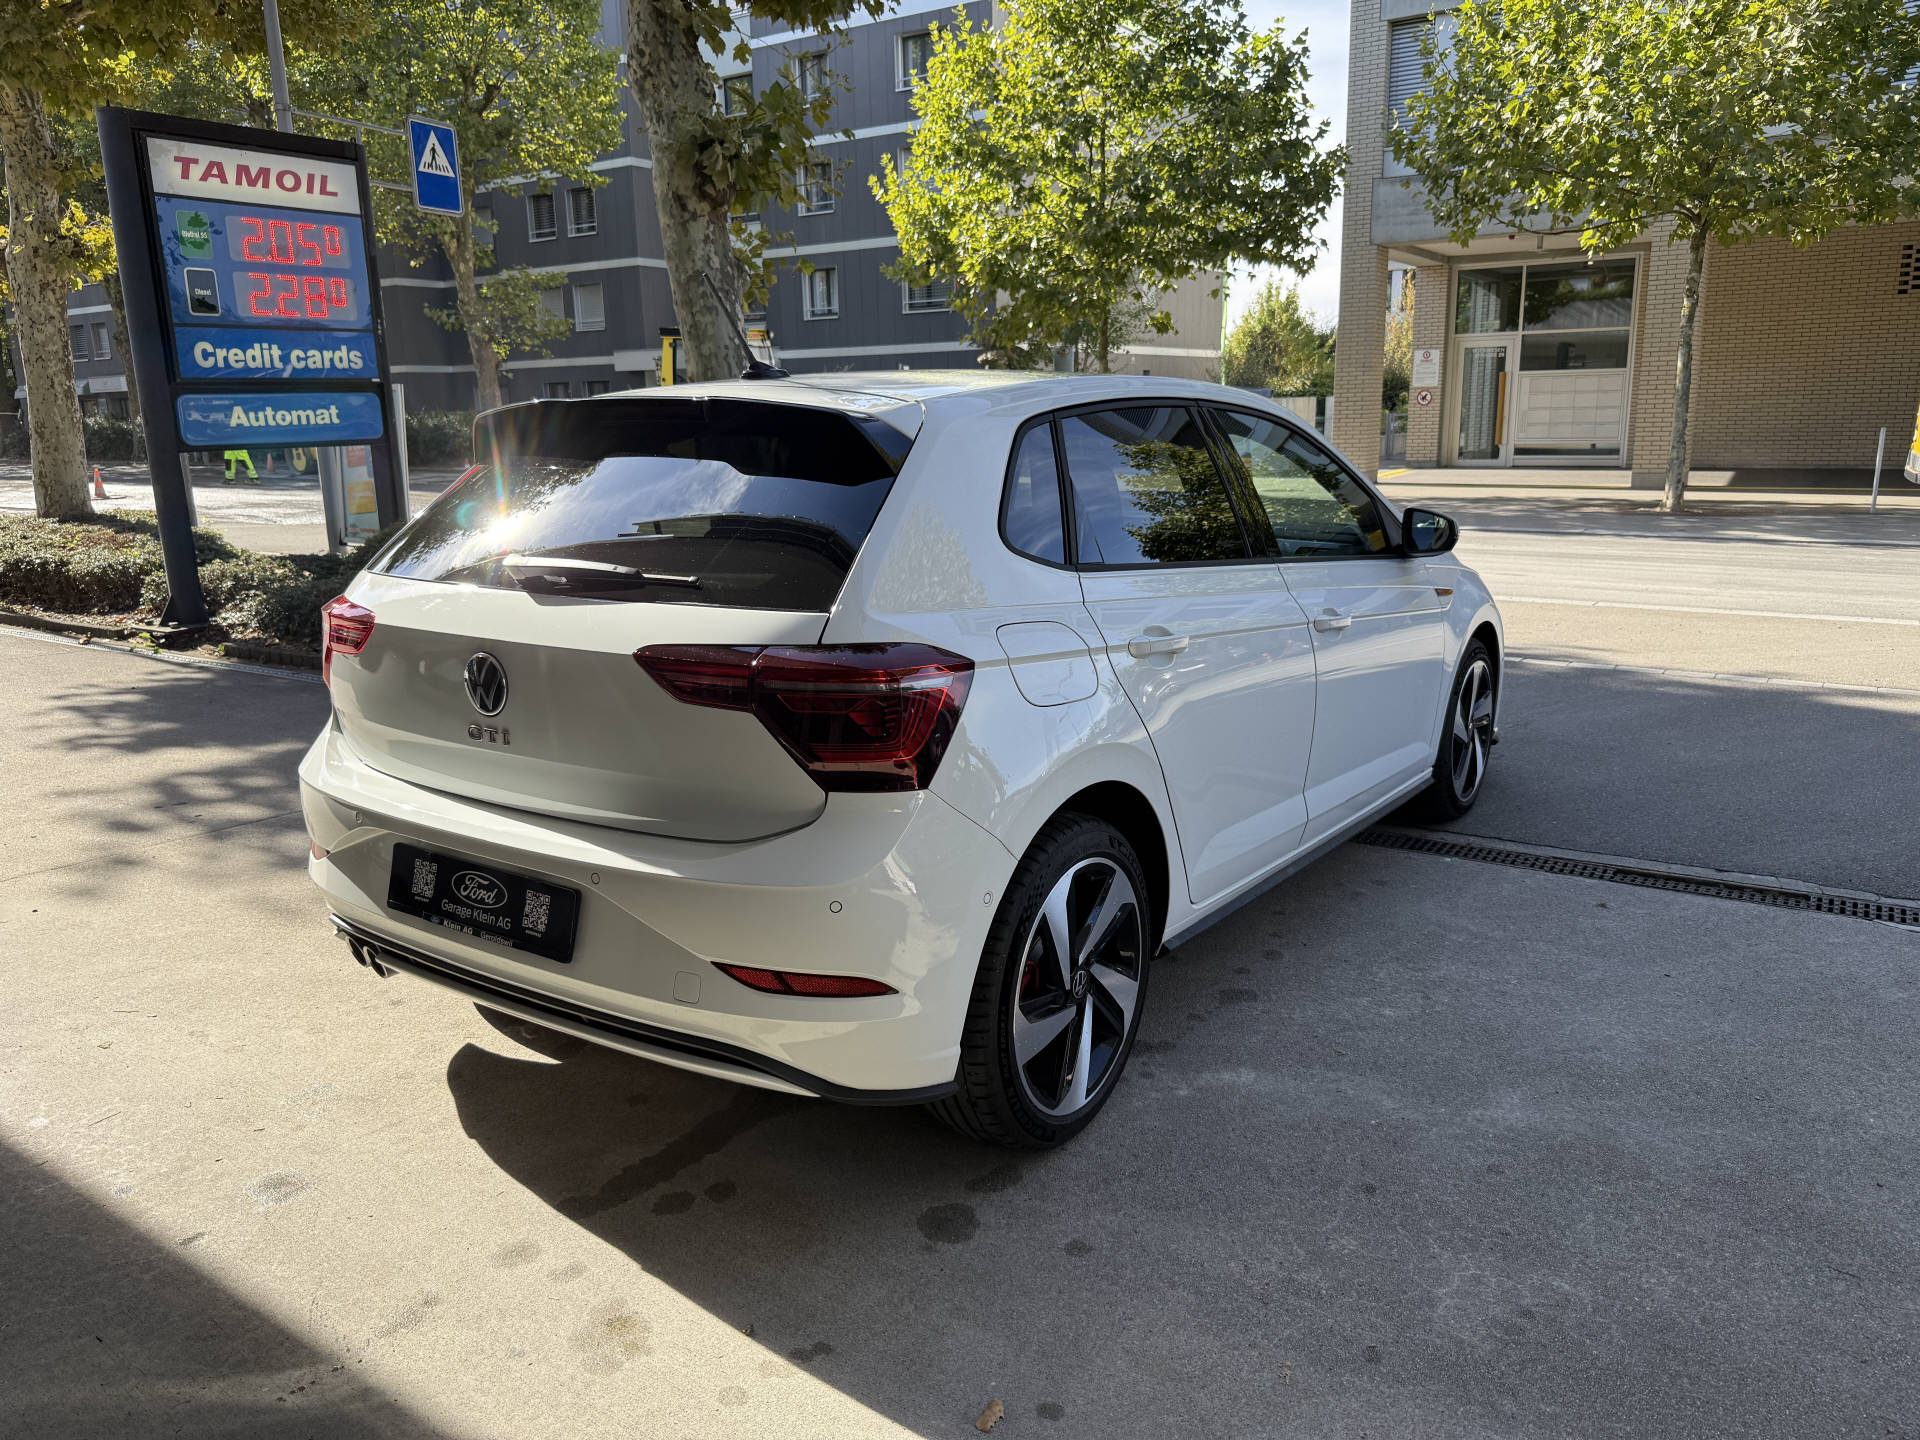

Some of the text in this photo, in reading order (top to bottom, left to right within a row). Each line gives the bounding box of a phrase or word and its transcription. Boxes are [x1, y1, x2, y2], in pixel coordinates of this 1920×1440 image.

[173, 156, 339, 197] TAMOIL
[193, 341, 363, 370] Credit cards
[229, 404, 340, 427] Automat
[468, 724, 511, 746] GTI
[460, 873, 498, 905] Ford
[441, 898, 512, 931] Garage Klein AG
[443, 919, 461, 933] Klein
[462, 925, 473, 935] AG
